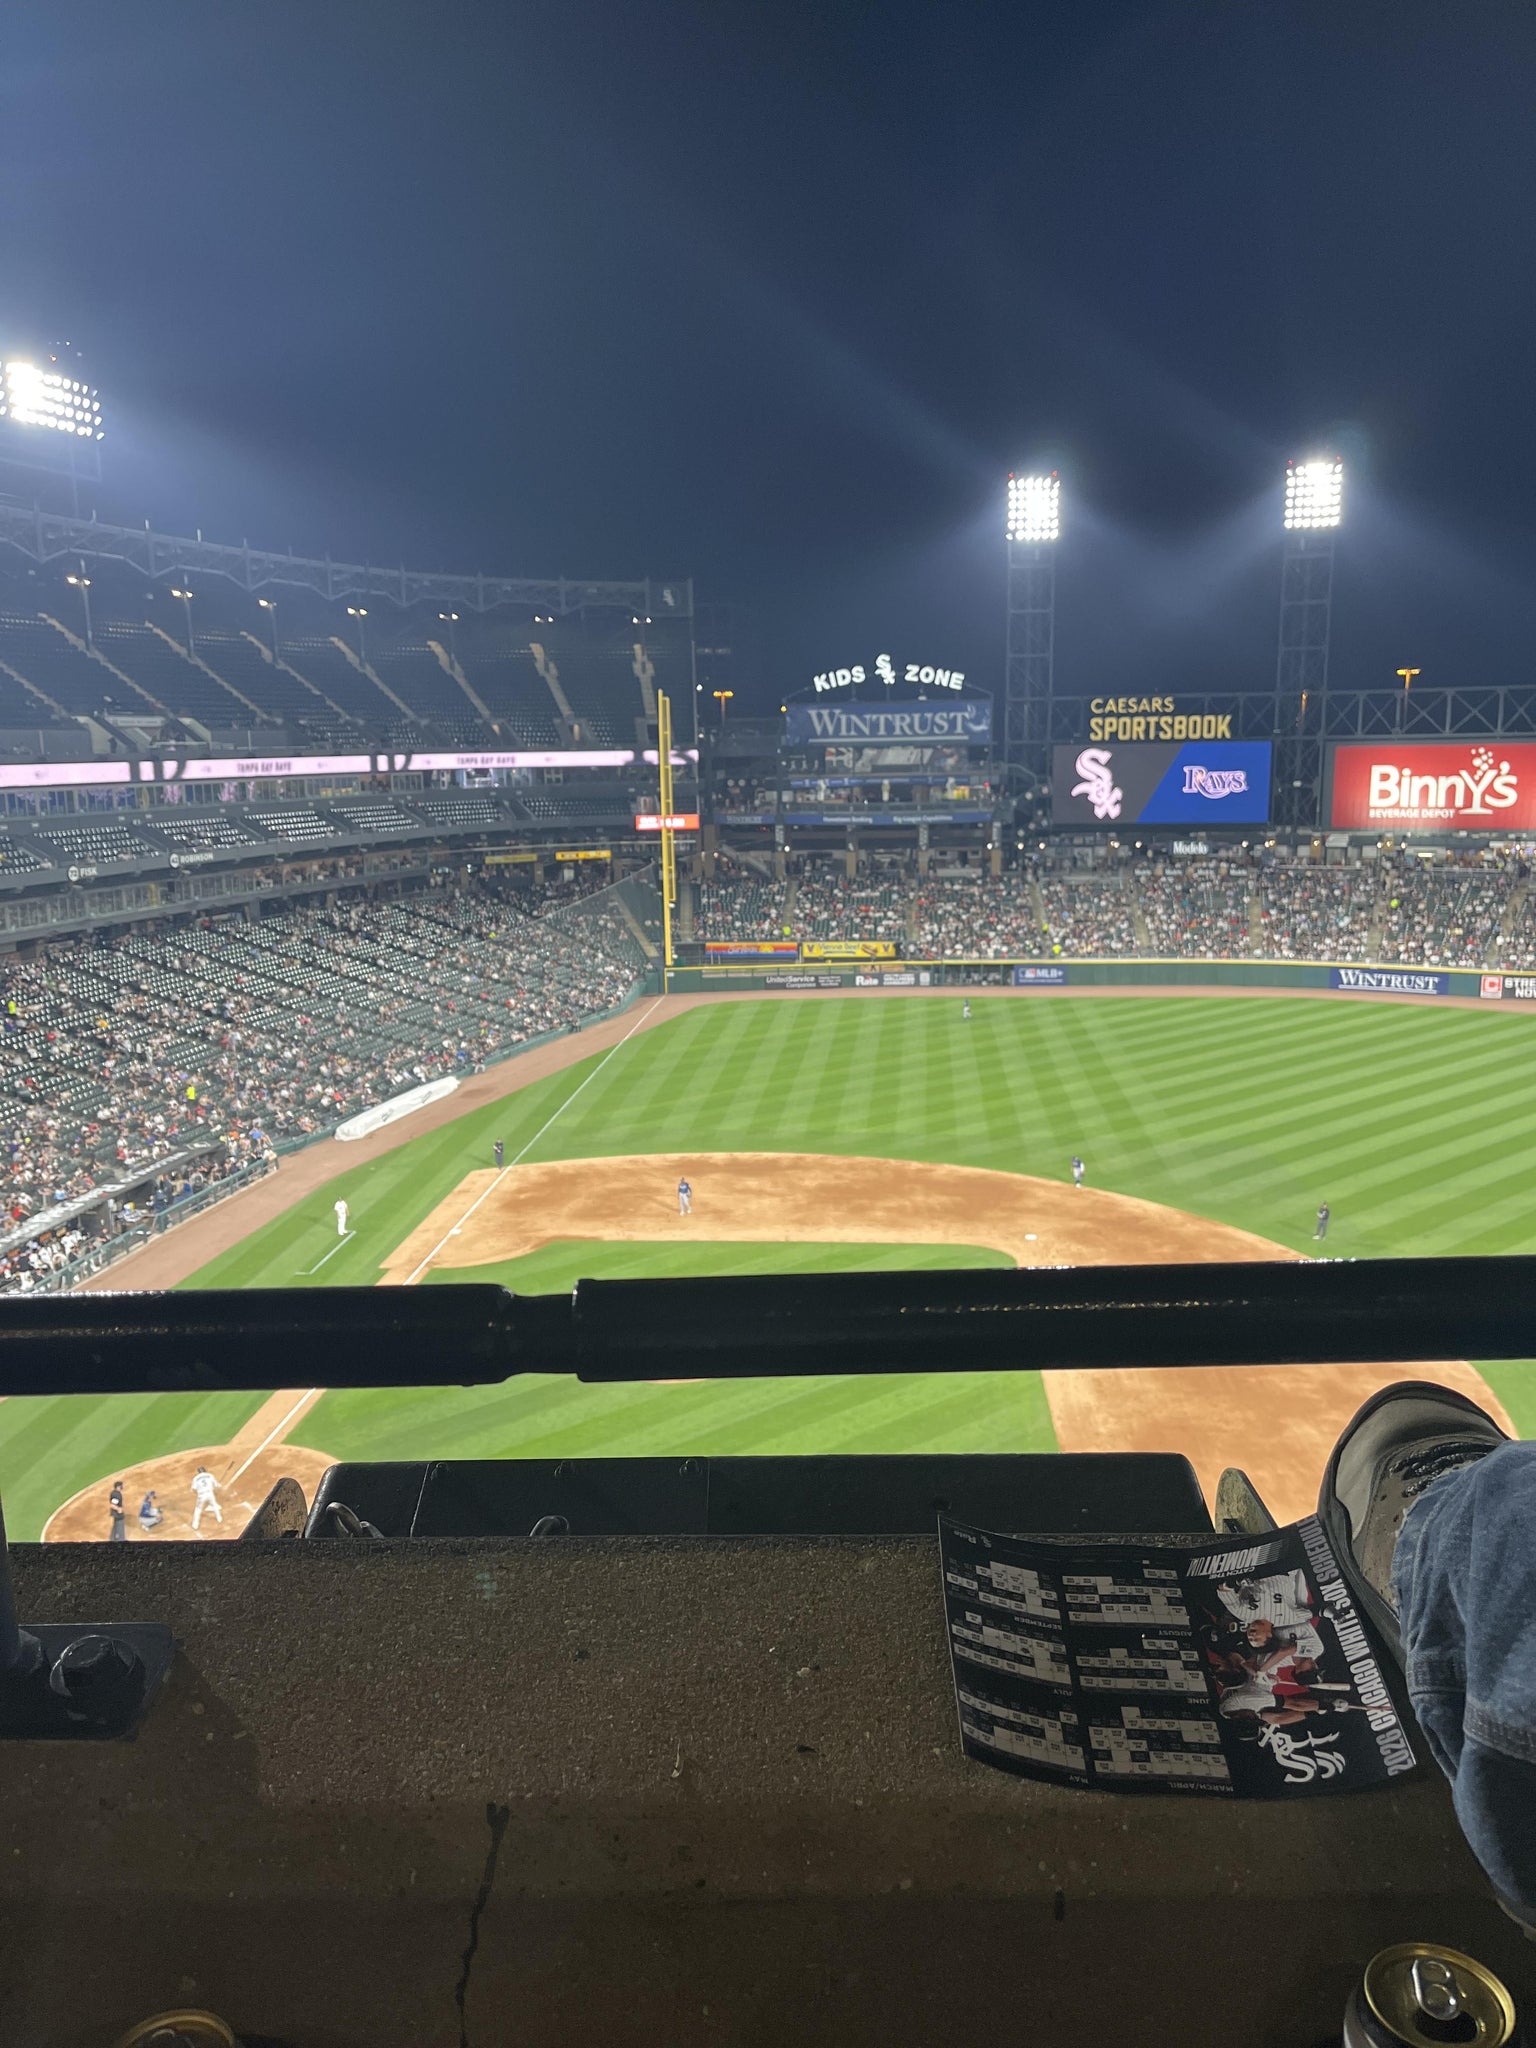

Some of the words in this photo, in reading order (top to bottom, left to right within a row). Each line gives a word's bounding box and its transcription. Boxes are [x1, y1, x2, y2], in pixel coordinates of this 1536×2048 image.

[813, 665, 866, 692] KIDS
[904, 664, 965, 691] ZONE
[1090, 696, 1175, 714] CAESARS
[808, 708, 969, 737] WINTRUST
[1089, 714, 1233, 741] SPORTSBOOK
[1369, 808, 1420, 819] BEVERAGE
[1421, 808, 1456, 819] DEPOT
[1173, 841, 1209, 855] Modelo
[180, 852, 214, 864] ROBINSON
[80, 866, 98, 878] FISK
[855, 975, 879, 986] Rate
[1338, 968, 1438, 990] WINTRUST
[1515, 987, 1536, 998] NO
[1186, 1546, 1261, 1576] MOMENTUM
[1208, 1571, 1226, 1580] THE
[1226, 1566, 1255, 1576] CATCH
[1273, 1593, 1283, 1604] 5
[1320, 1578, 1352, 1613] SOX
[1013, 1616, 1062, 1631] SEPTEMBER
[1158, 1629, 1193, 1637] AUGUST
[1053, 1688, 1072, 1697] JULY
[1350, 1656, 1397, 1732] CHICAGO
[1375, 1727, 1413, 1777] 2026
[1069, 1775, 1089, 1784] MAY
[1167, 1781, 1234, 1792] MARCH/APRIL
